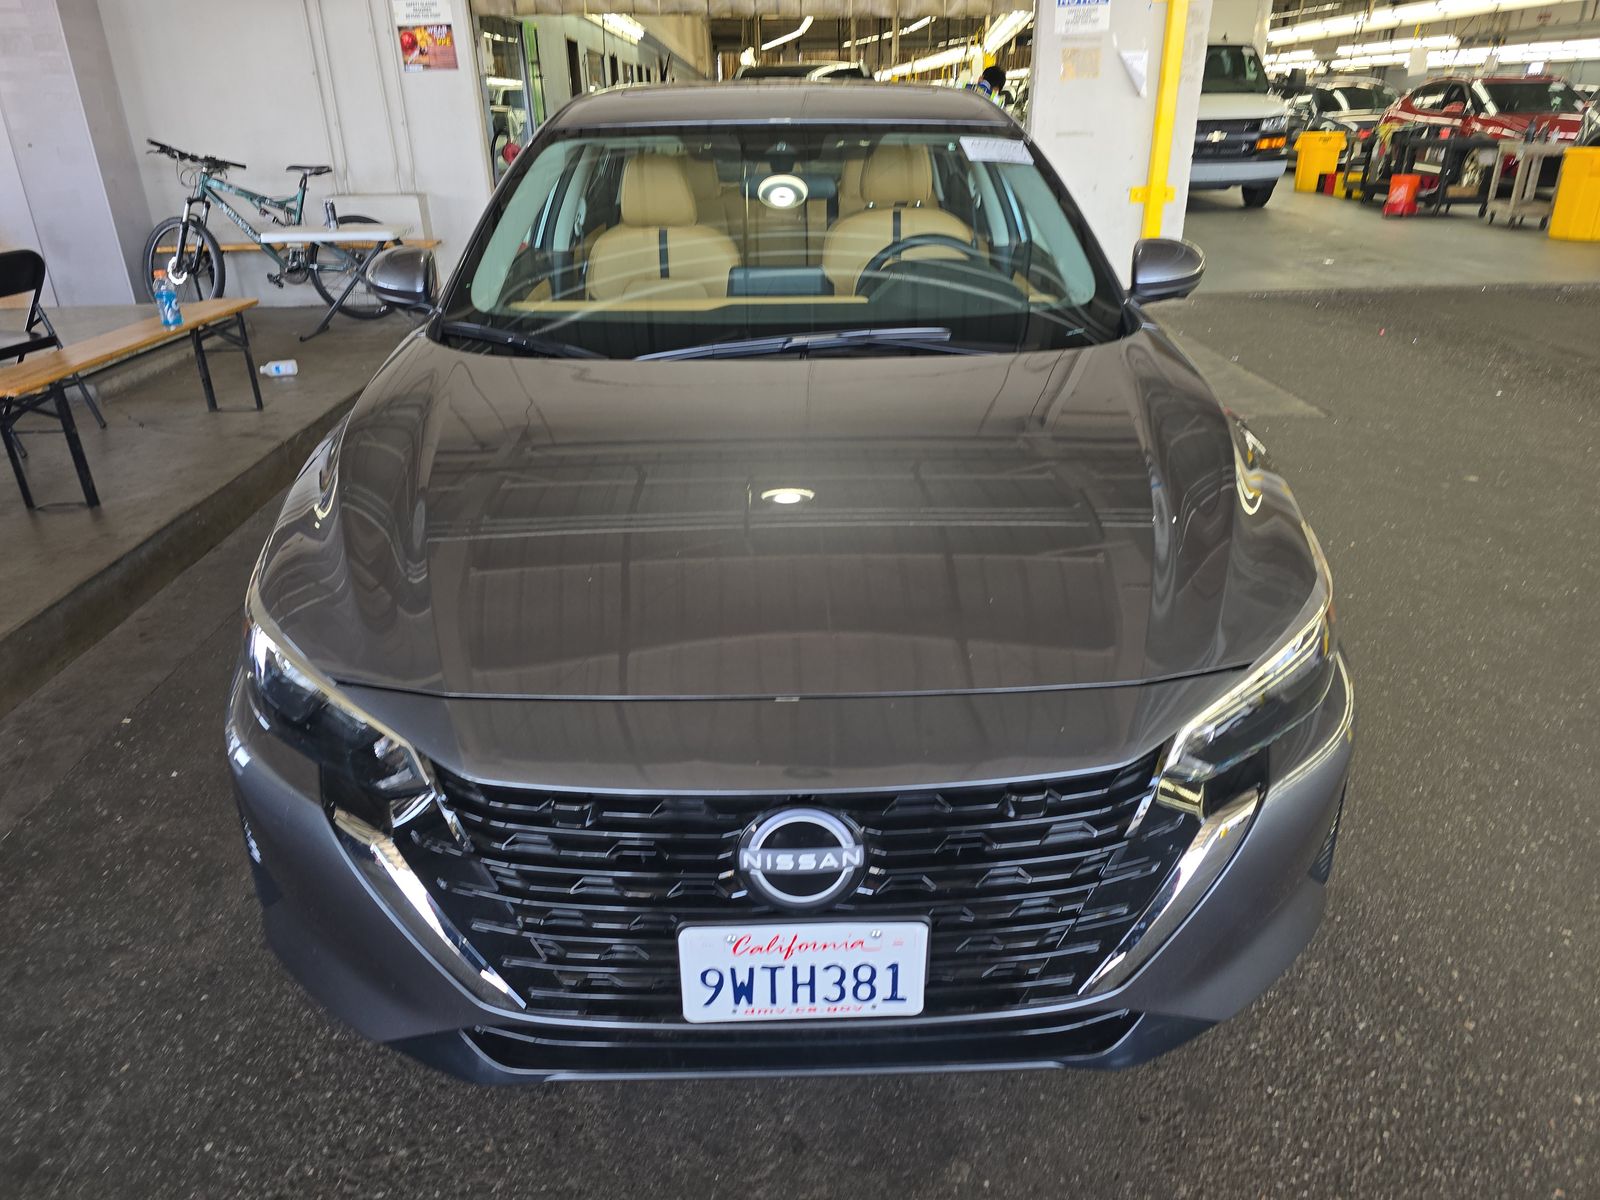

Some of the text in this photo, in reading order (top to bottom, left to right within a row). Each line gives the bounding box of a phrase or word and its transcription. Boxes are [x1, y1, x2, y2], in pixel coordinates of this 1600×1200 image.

[743, 850, 860, 870] NISSAN
[732, 933, 867, 960] California
[700, 962, 907, 1008] 9WTH381
